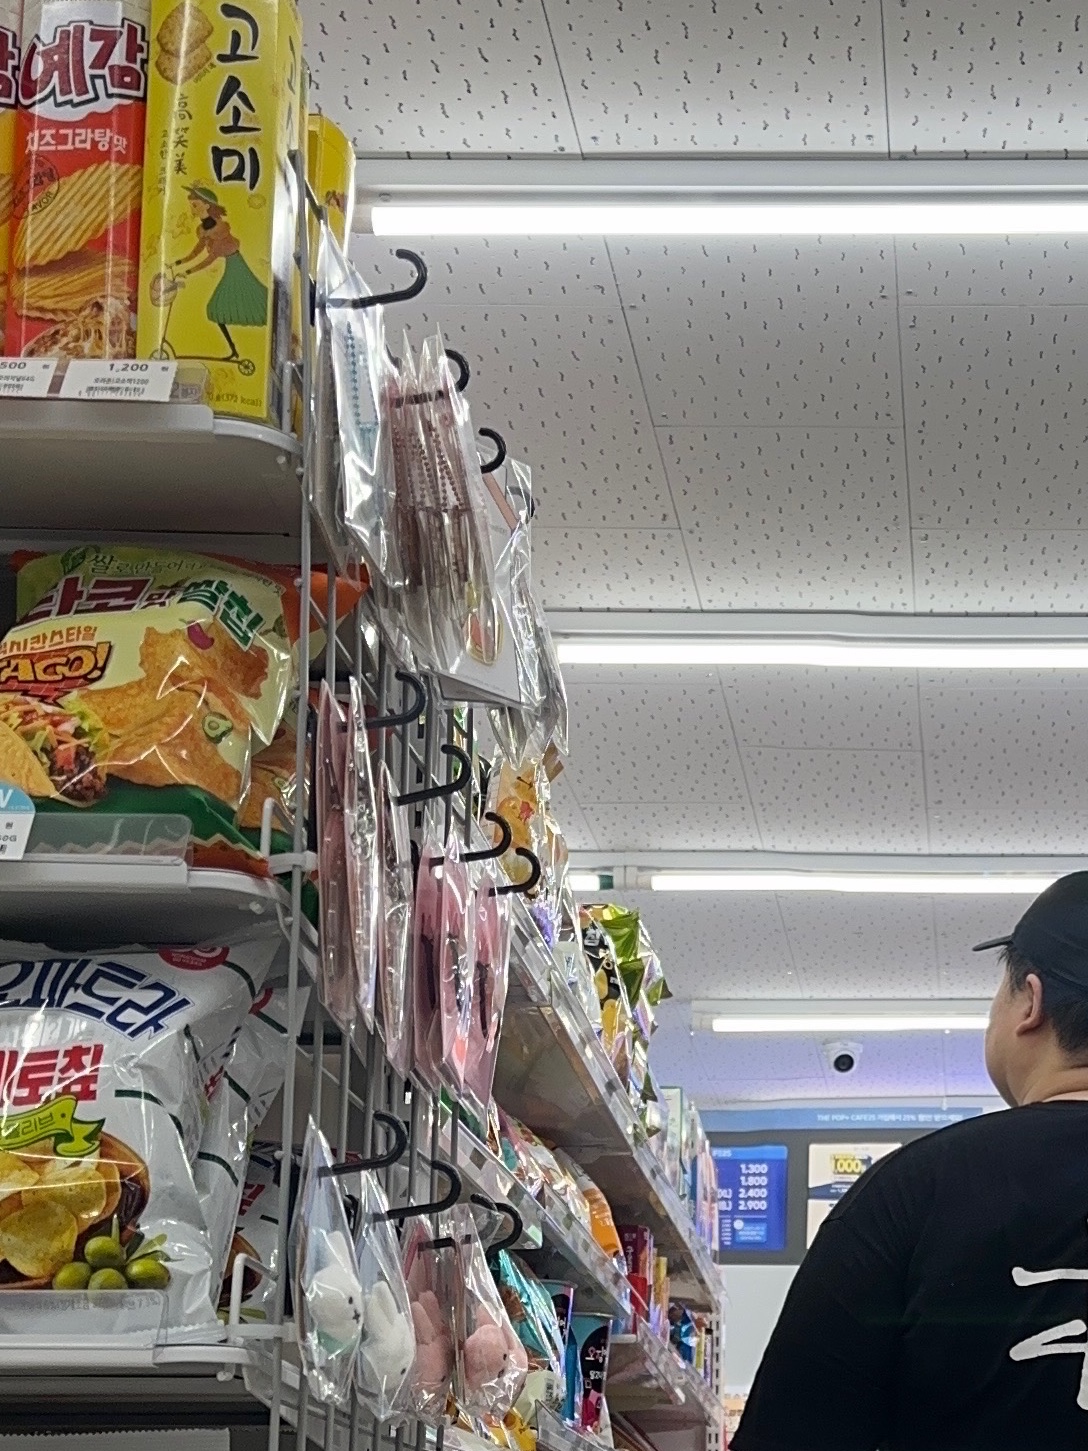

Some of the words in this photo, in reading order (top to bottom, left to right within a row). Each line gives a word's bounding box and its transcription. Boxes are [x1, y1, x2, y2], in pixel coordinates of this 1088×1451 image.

[20, 20, 149, 107] 예감
[211, 3, 262, 190] 고소미
[109, 363, 149, 373] 1,200
